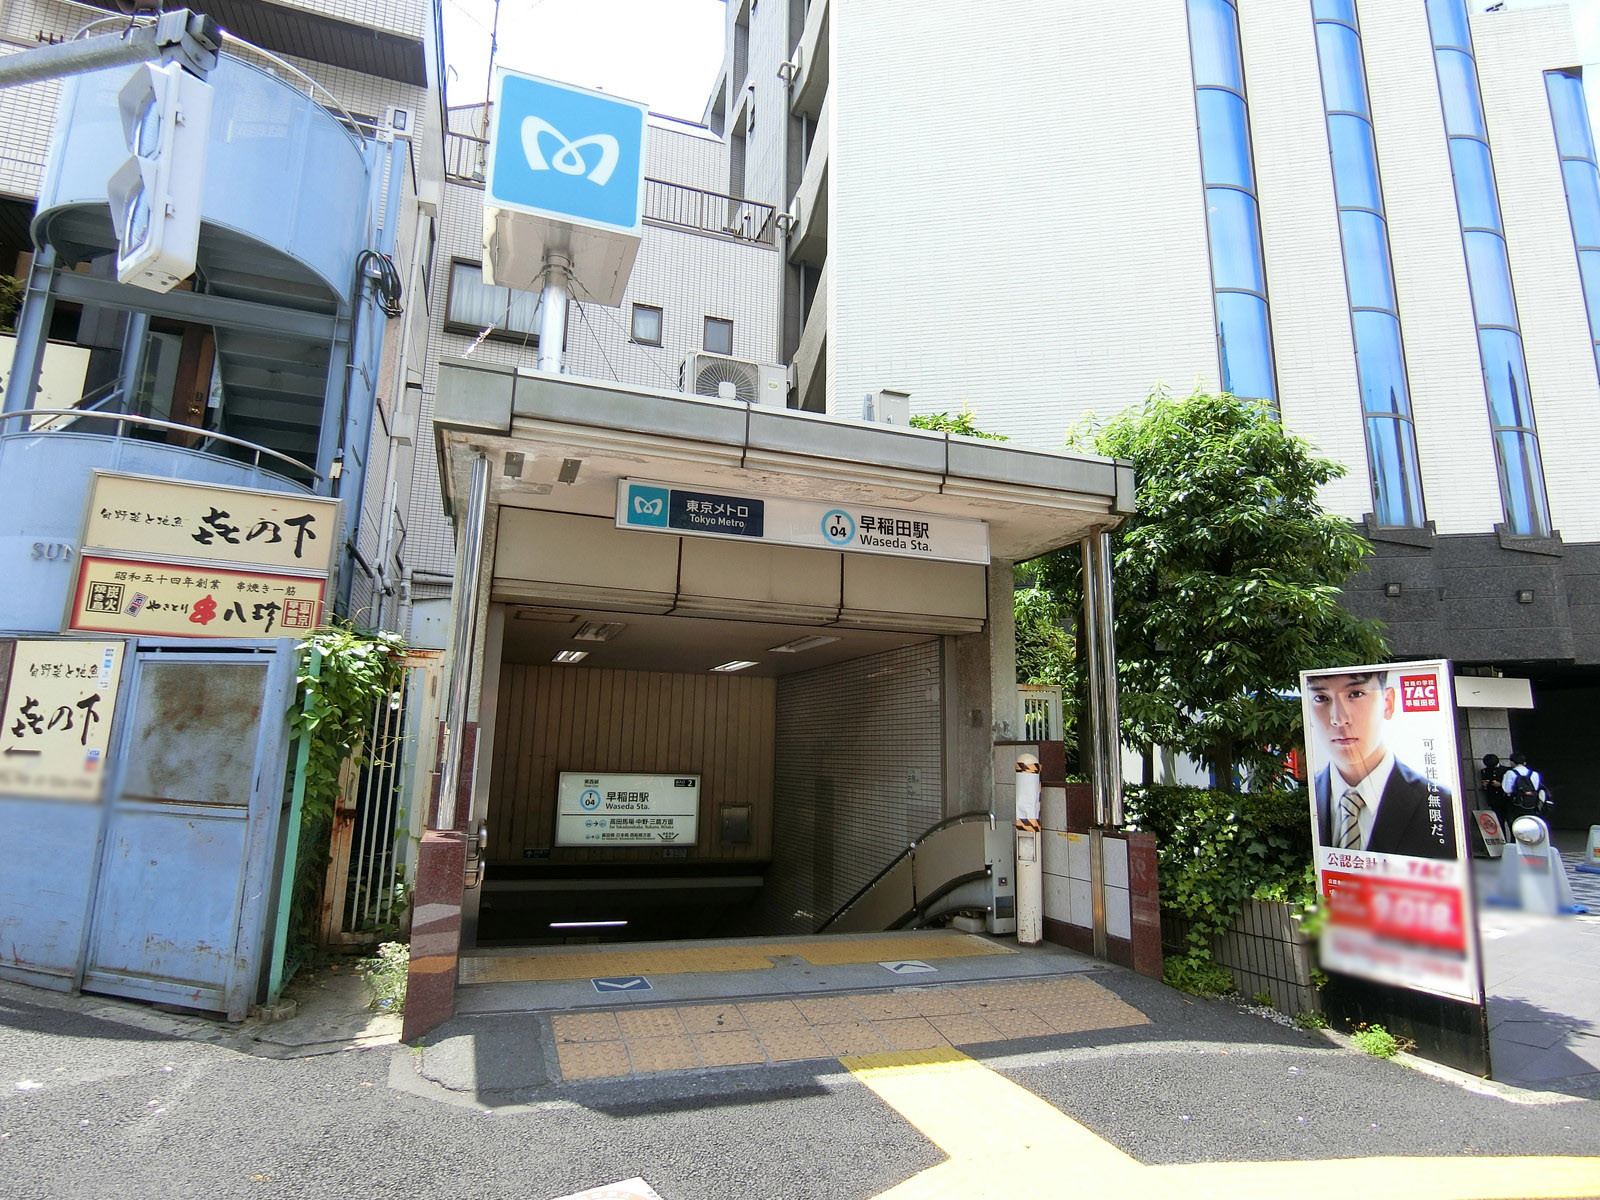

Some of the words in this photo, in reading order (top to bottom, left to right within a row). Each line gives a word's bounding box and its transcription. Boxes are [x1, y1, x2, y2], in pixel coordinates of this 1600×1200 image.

[686, 499, 749, 518] 東京メトロ
[689, 513, 716, 526] Tokyo
[718, 517, 745, 528] Metro
[834, 515, 842, 525] T
[859, 515, 930, 539] 早稲田駅
[829, 525, 847, 538] 04
[859, 534, 907, 549] Waseda
[910, 539, 932, 552] Sta.
[114, 571, 221, 590] 昭和五十四年創業
[146, 599, 189, 614] やきとり
[1404, 686, 1435, 699] TAC
[687, 779, 693, 787] 2
[606, 791, 650, 802] 早稲田駅
[1422, 738, 1445, 845] 可能性は無限だ。
[585, 798, 595, 806] 04
[606, 802, 634, 810] Waseda
[636, 802, 650, 810] Sta.
